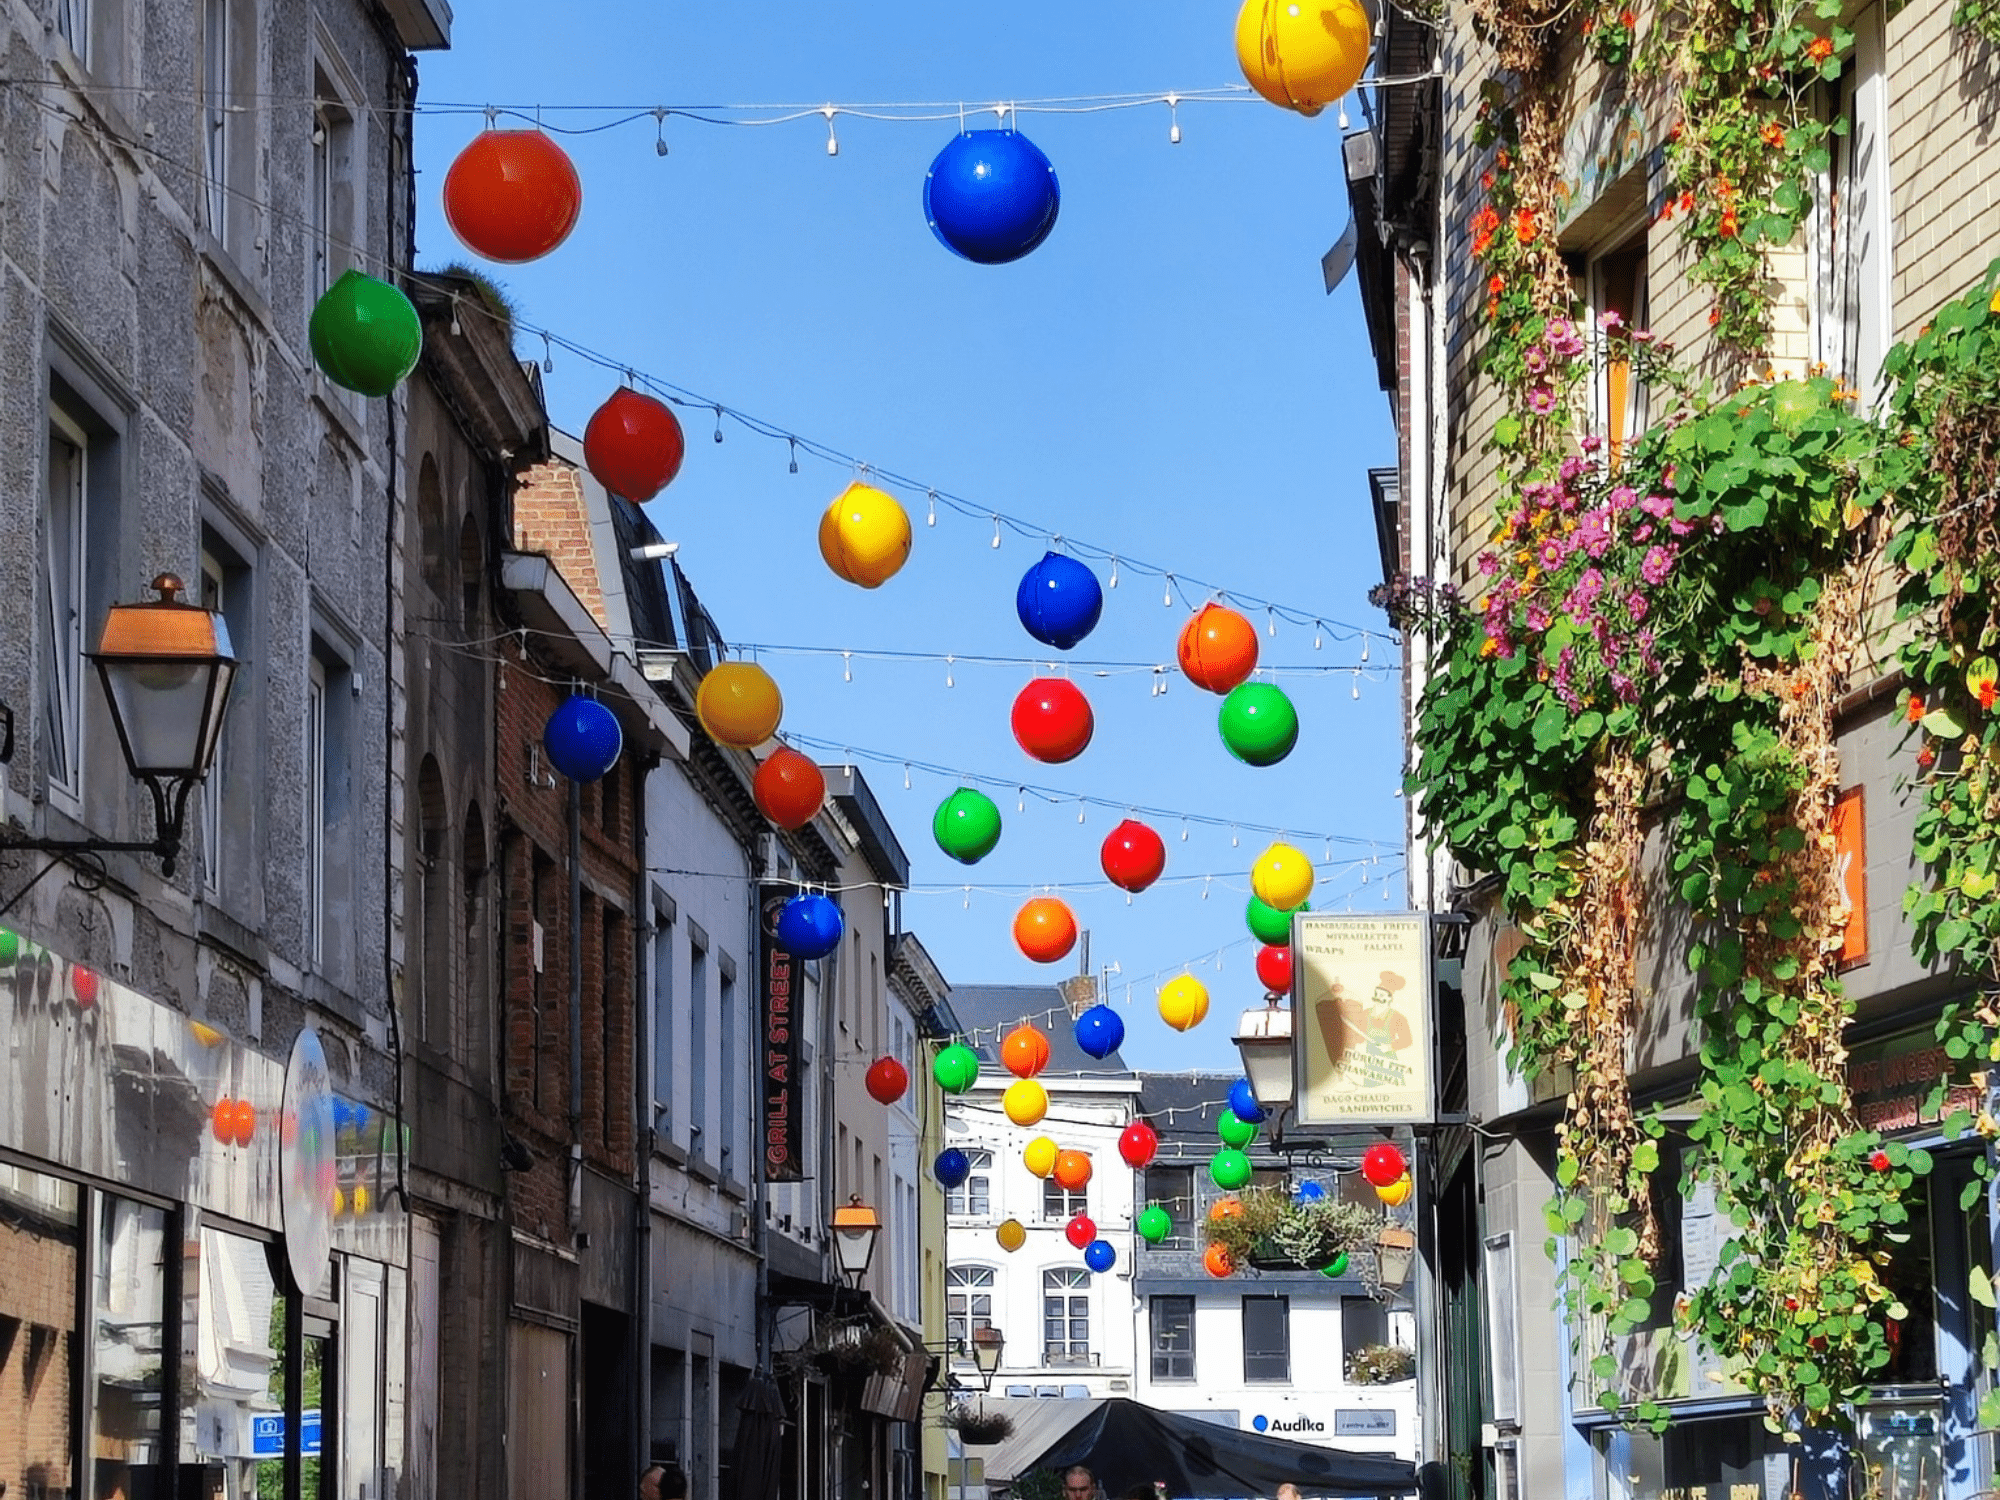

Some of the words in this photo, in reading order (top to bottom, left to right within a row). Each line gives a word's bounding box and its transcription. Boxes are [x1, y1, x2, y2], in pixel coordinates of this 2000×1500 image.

[1305, 922, 1376, 931] HAMBURGERS
[1383, 922, 1419, 931] FRITES
[1305, 944, 1344, 955] WRAPS
[768, 948, 791, 1044] STREET
[768, 1051, 788, 1083] AT
[1353, 1094, 1390, 1103] CHAUD
[1338, 1104, 1413, 1113] SANDWICHES
[767, 1089, 788, 1165] GRILL
[1271, 1418, 1325, 1432] Audika
